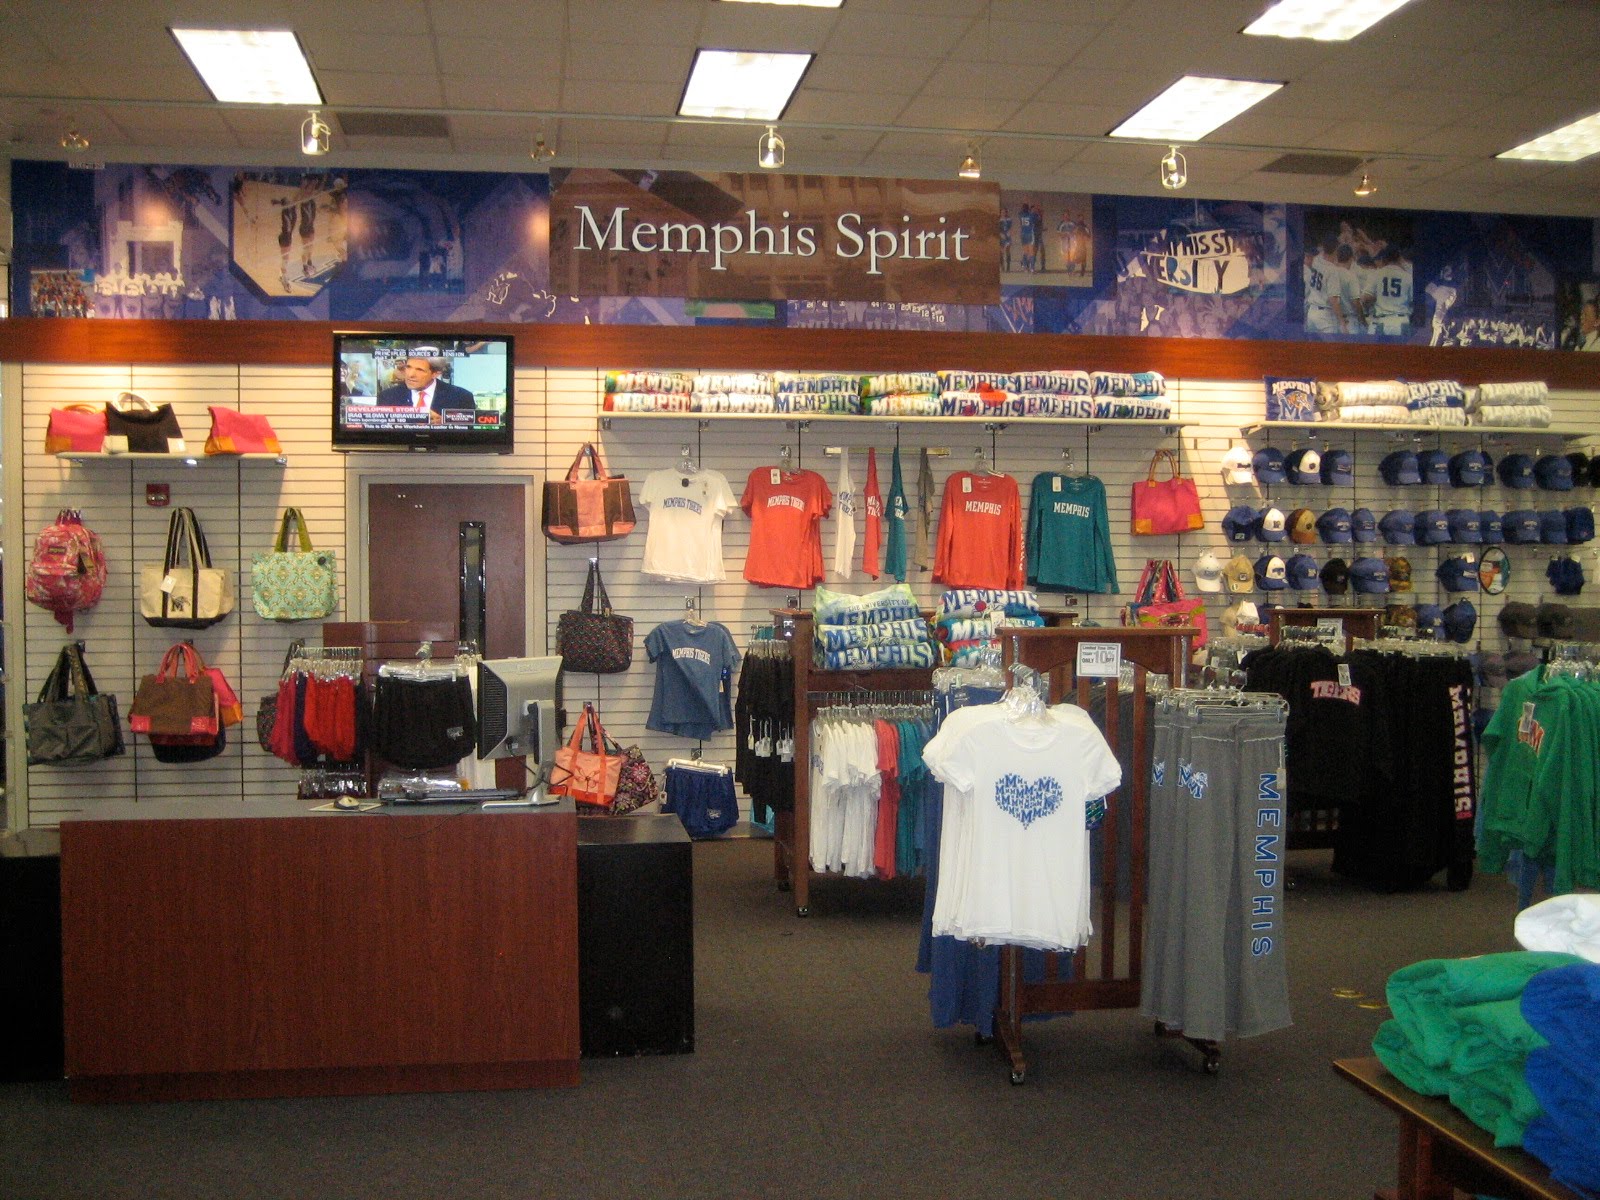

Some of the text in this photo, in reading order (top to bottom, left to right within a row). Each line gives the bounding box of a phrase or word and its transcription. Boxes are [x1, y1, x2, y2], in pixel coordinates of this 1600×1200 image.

[573, 205, 970, 274] Memphis Spirit
[1382, 277, 1402, 297] 15
[663, 496, 686, 508] MEMPHIS
[767, 495, 805, 512] MEMPHIS TIGERS
[965, 500, 1002, 516] MEMPHIS
[1053, 502, 1090, 518] MEMPHIS
[861, 600, 901, 610] UNIVERSITY
[942, 589, 1040, 614] MEMPHIS
[825, 618, 928, 652] MEMPHIS
[672, 647, 711, 665] MEMPHIS TIGERS
[825, 641, 930, 669] MEMPHIS
[1251, 773, 1281, 956] MEMPHIS
